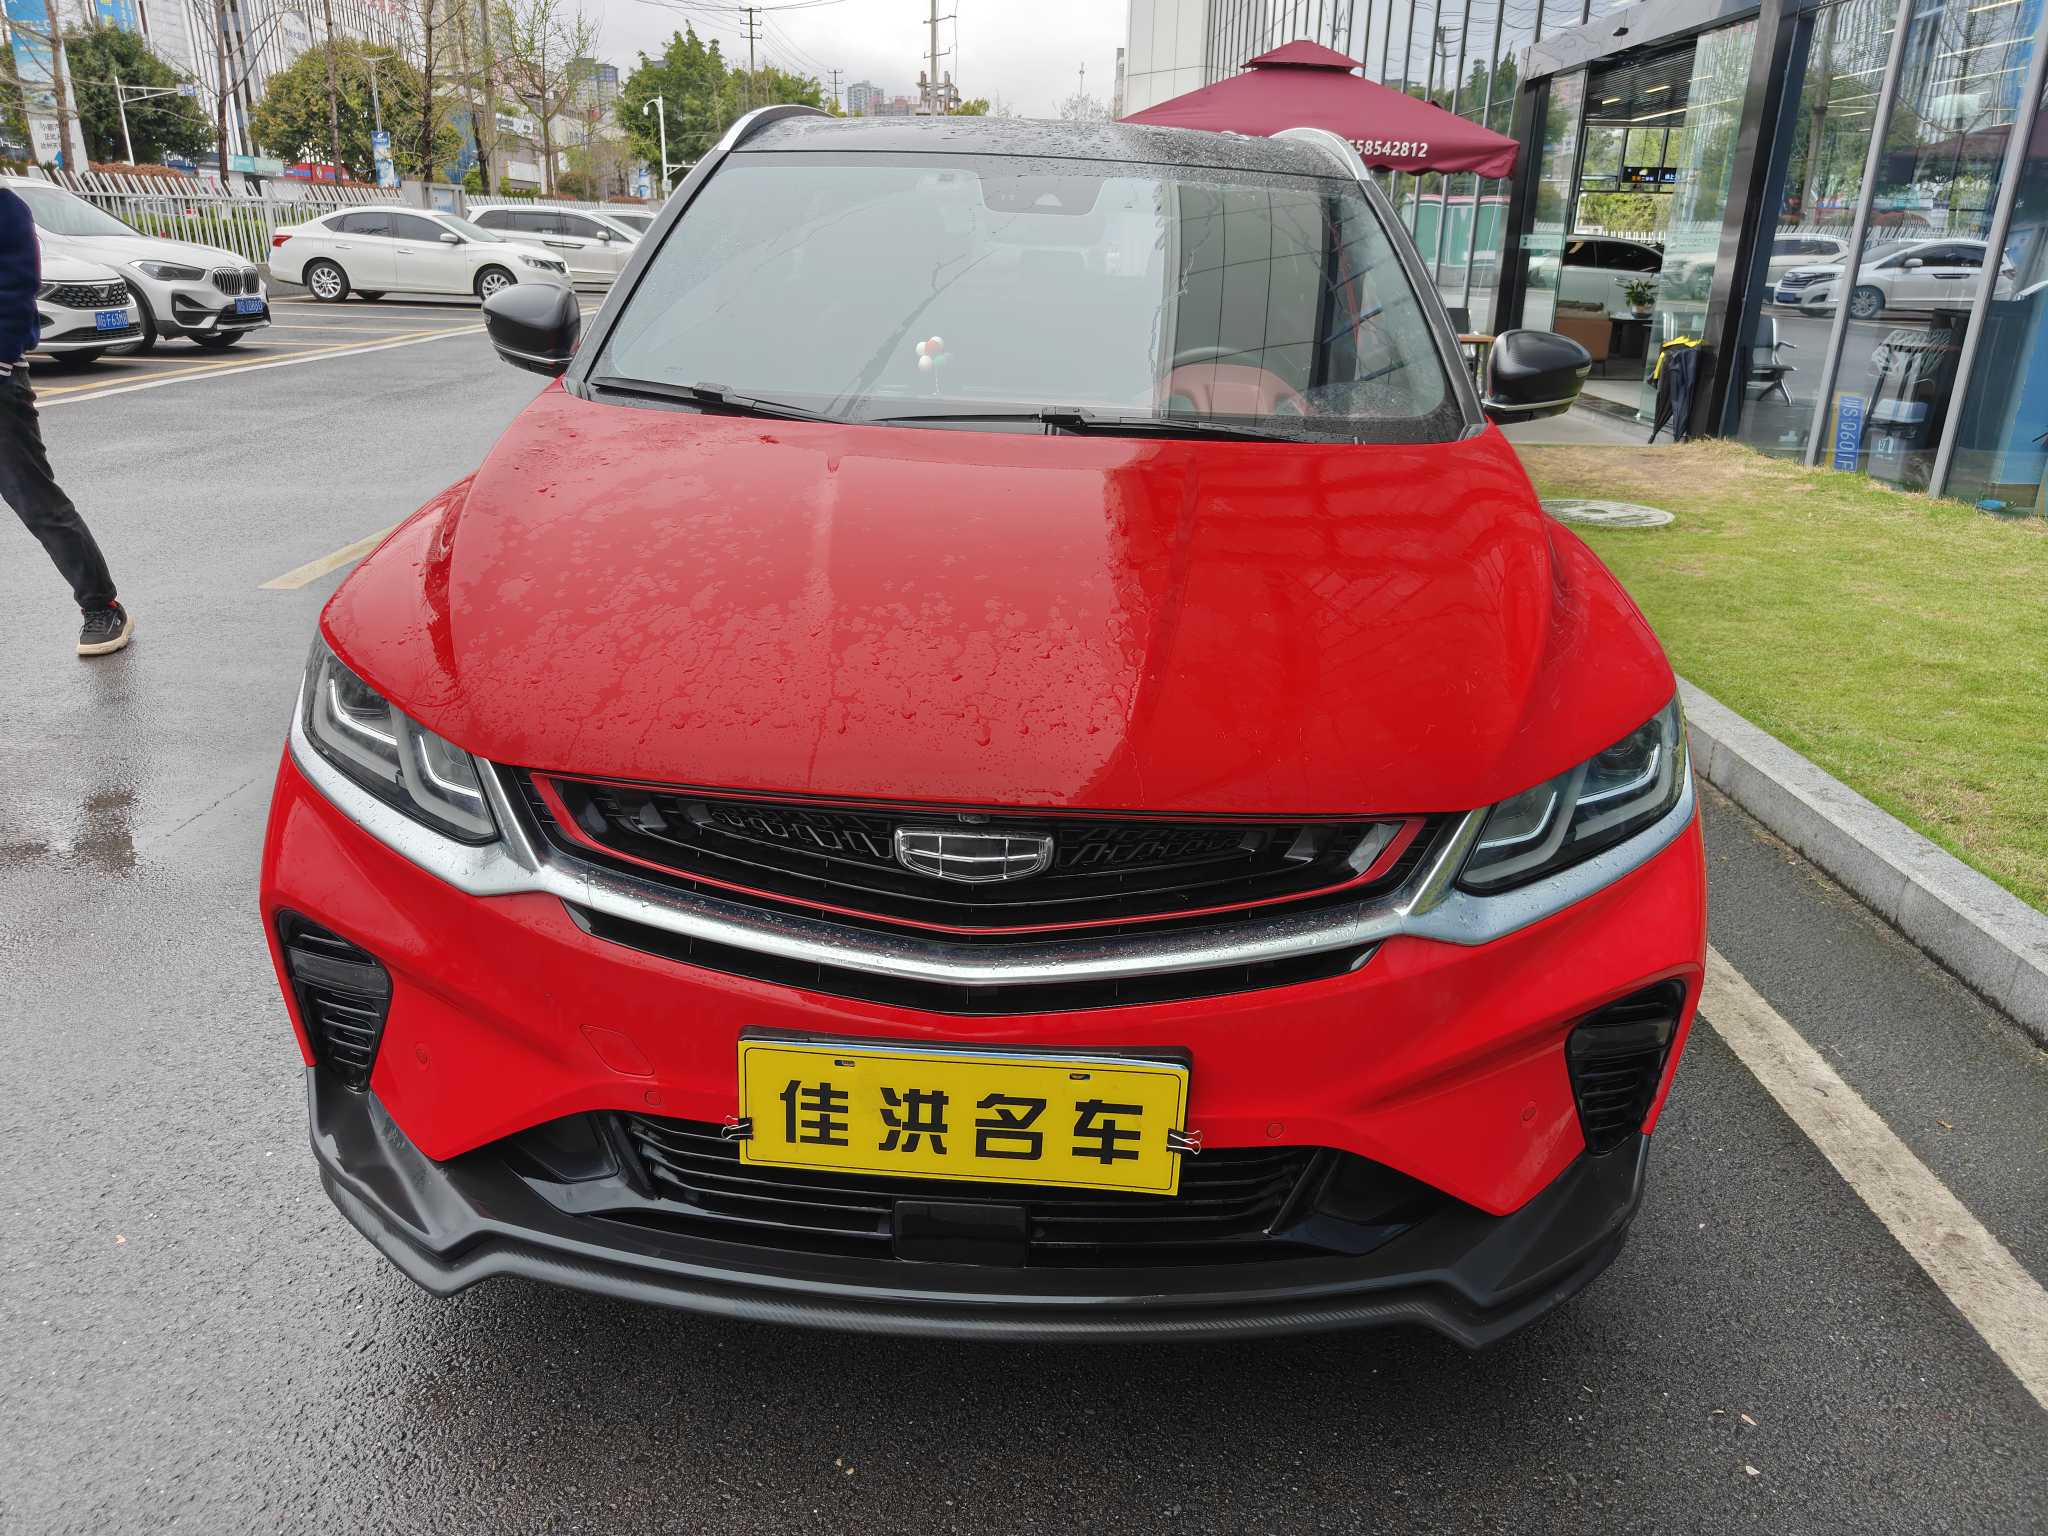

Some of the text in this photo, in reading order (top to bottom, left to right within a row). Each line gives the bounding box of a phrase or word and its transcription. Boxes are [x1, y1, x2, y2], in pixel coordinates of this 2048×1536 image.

[1348, 139, 1428, 158] 58542812
[779, 1079, 1144, 1165] 佳洪名车
